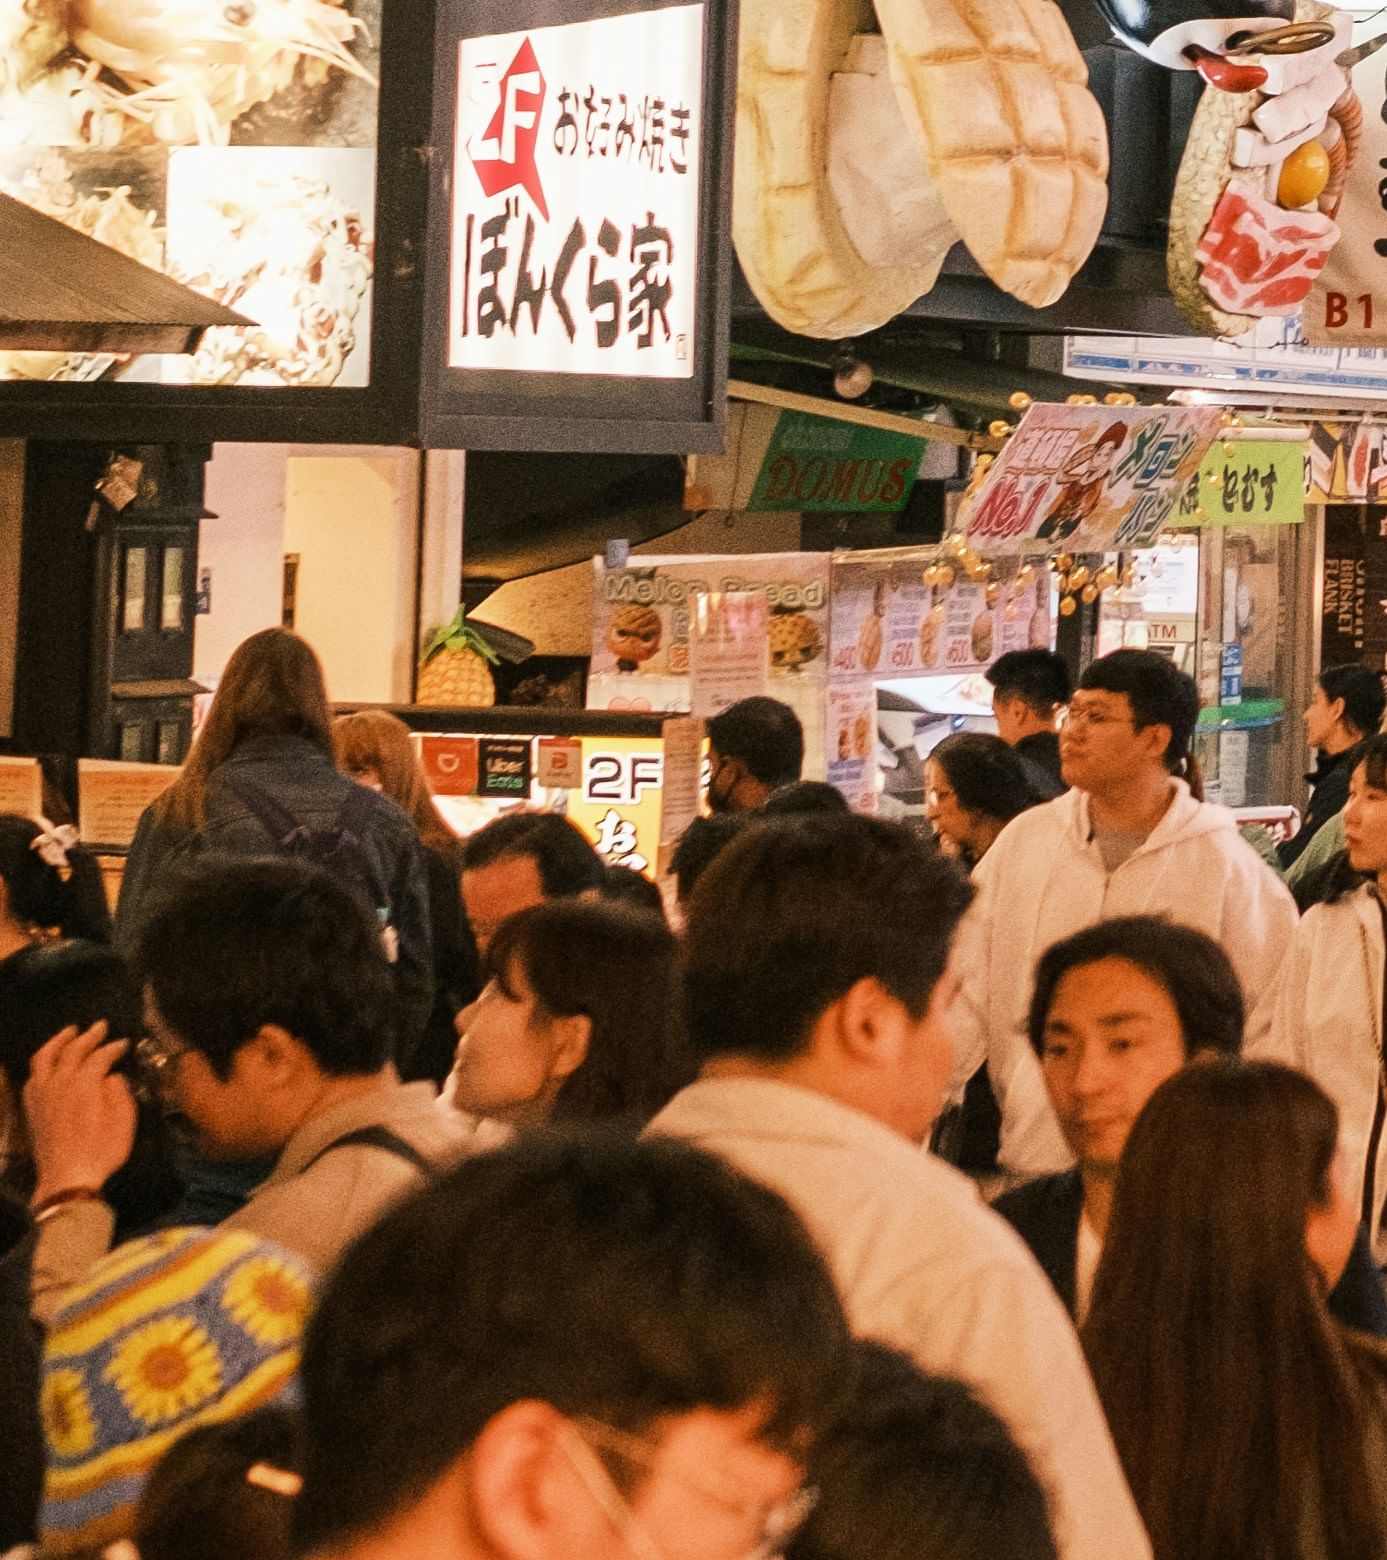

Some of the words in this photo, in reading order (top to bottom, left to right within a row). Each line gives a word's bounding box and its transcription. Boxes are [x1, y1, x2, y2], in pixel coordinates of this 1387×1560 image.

[552, 82, 692, 177] お好み焼き
[462, 197, 677, 349] ぼんくら家
[1324, 291, 1374, 330] B1
[585, 753, 662, 803] 2F
